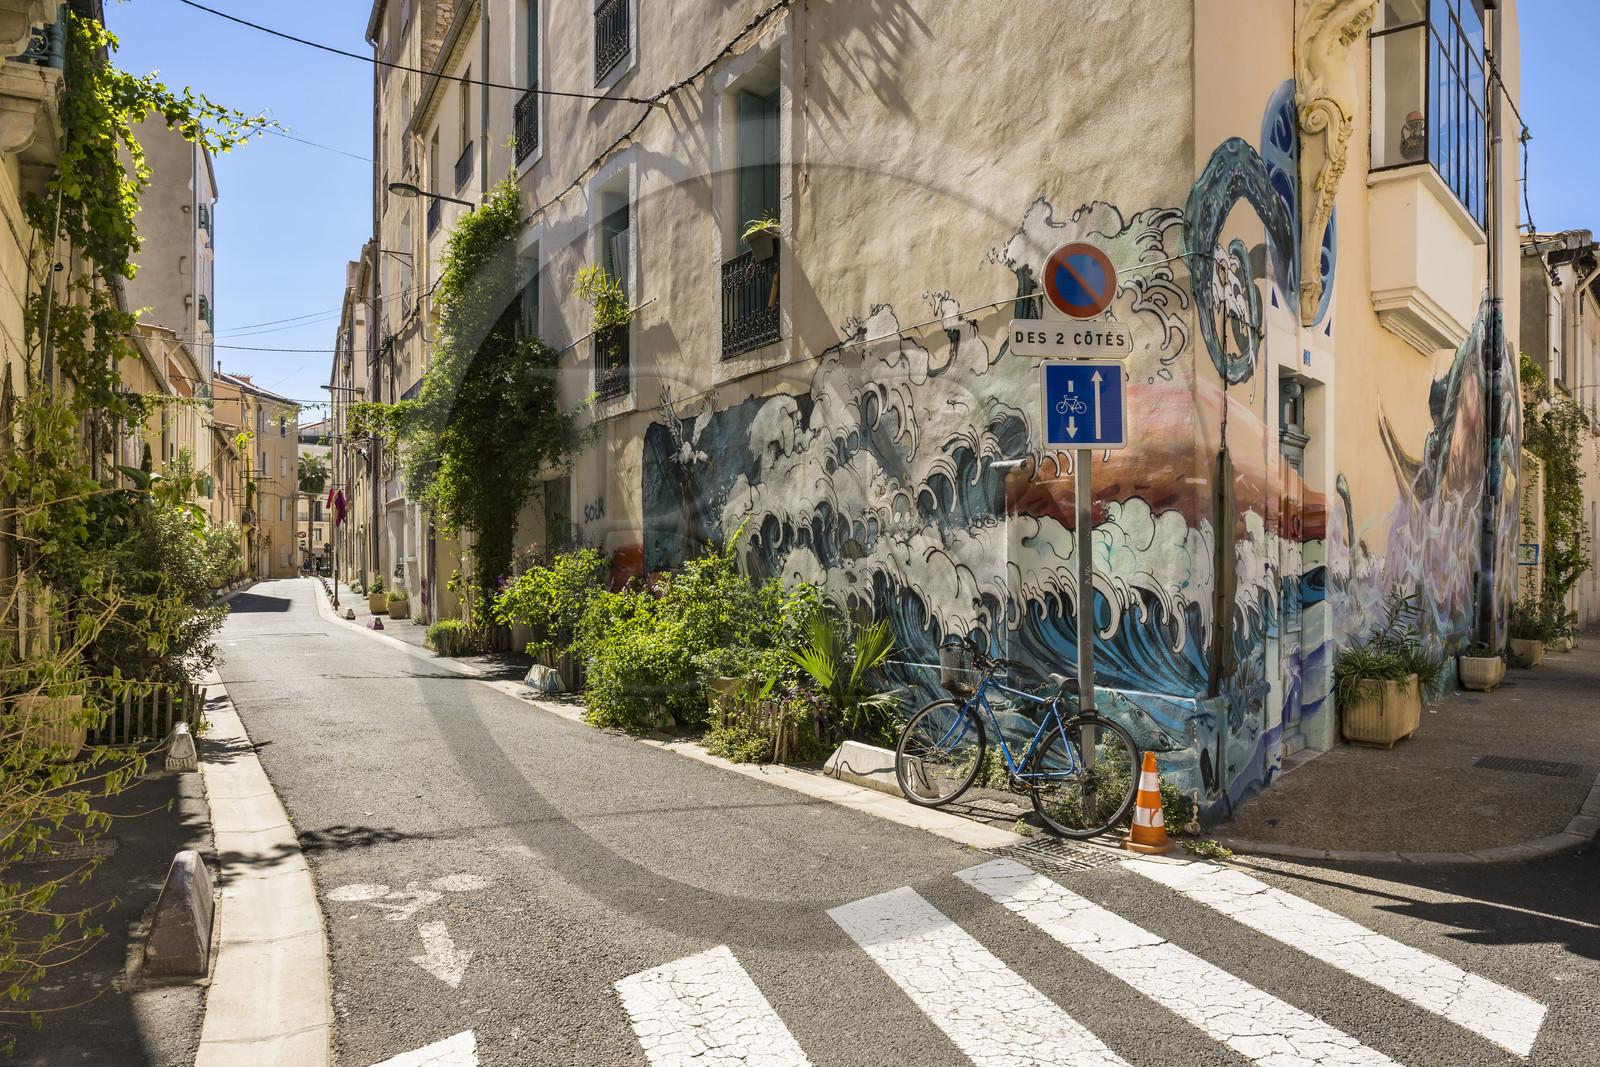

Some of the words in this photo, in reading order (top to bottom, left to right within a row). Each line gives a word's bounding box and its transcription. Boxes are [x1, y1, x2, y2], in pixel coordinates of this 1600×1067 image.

[1015, 331, 1047, 344] DES
[1055, 332, 1065, 345] 2
[1073, 331, 1125, 346] CÔTÉS
